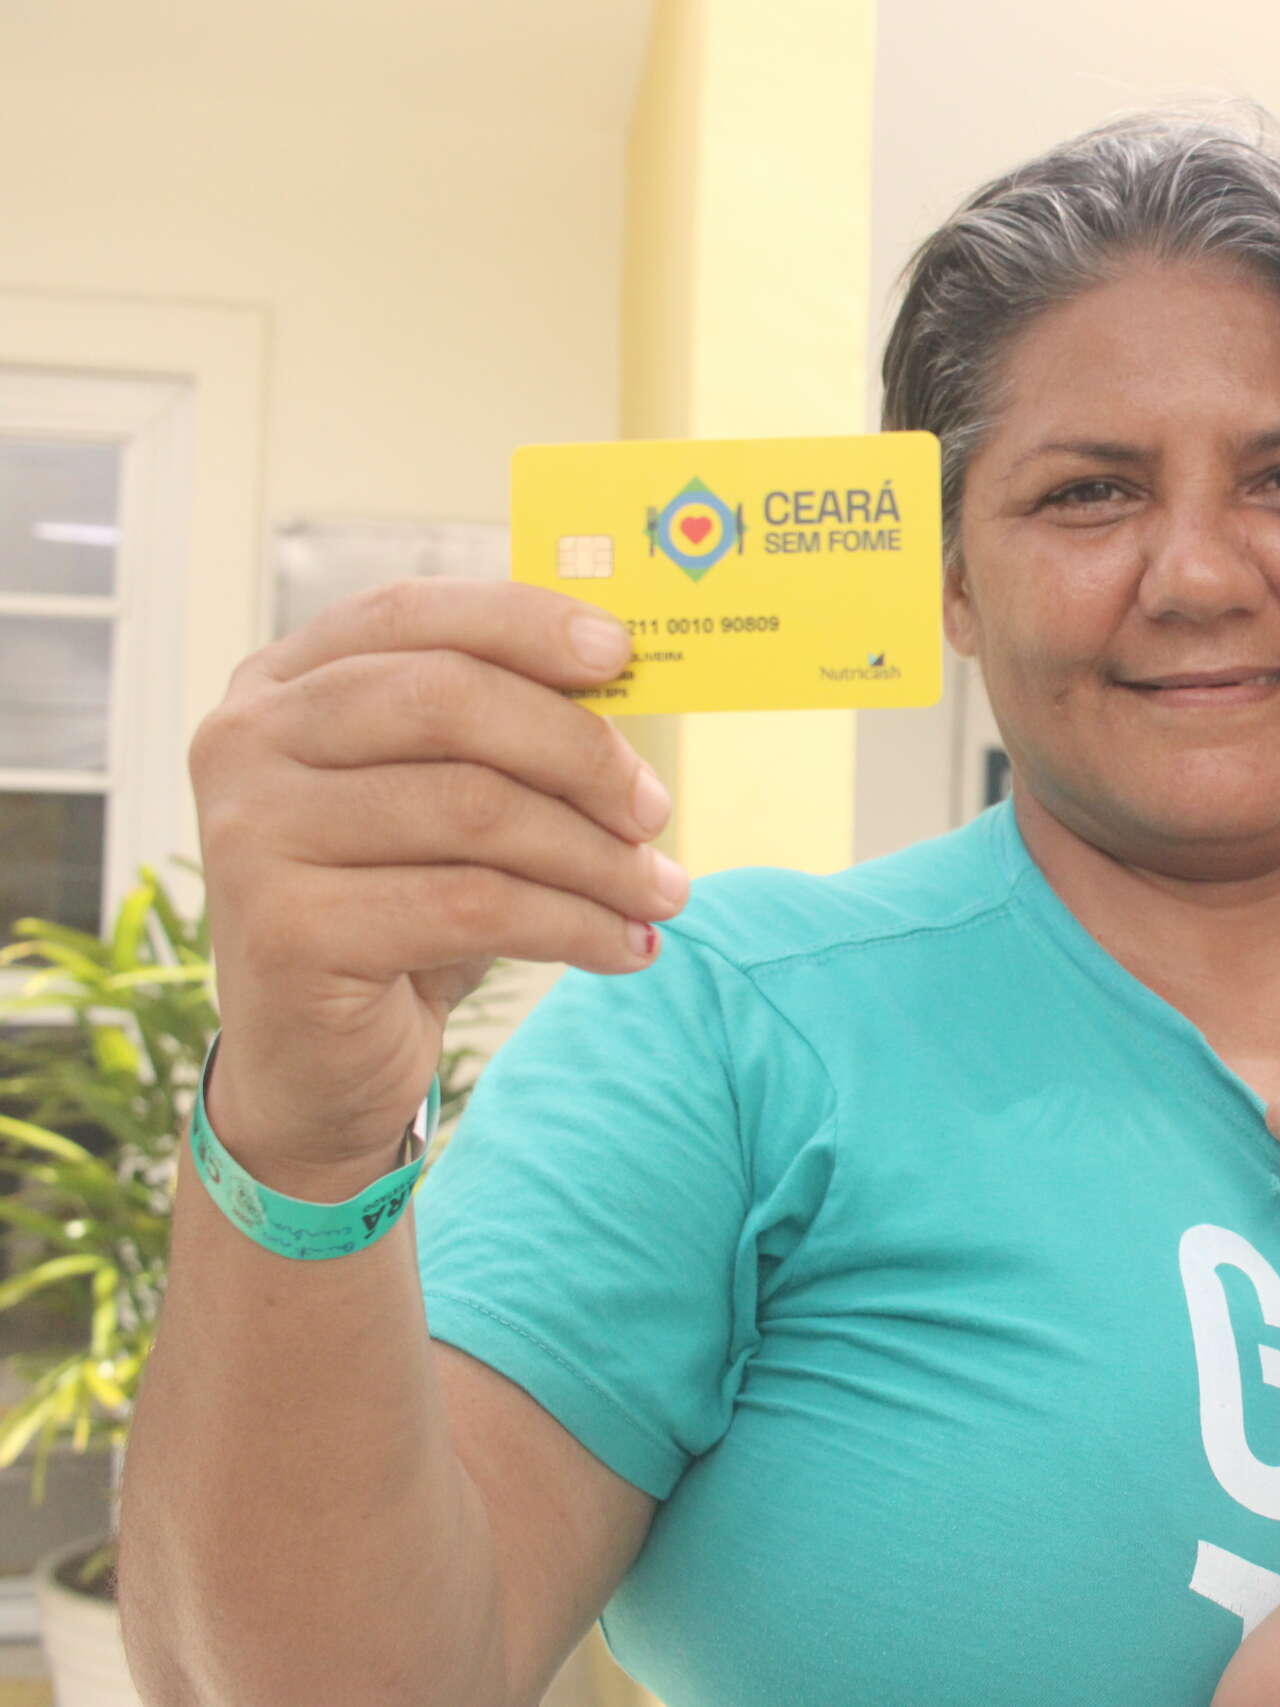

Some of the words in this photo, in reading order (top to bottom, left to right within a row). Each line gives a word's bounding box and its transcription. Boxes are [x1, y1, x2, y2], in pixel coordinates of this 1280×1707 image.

[764, 479, 901, 526] CEARÁ
[764, 531, 821, 554] SEM
[828, 529, 902, 552] FOME
[666, 617, 714, 634] 0010
[720, 615, 780, 632] 90809
[819, 663, 902, 682] Nutricash
